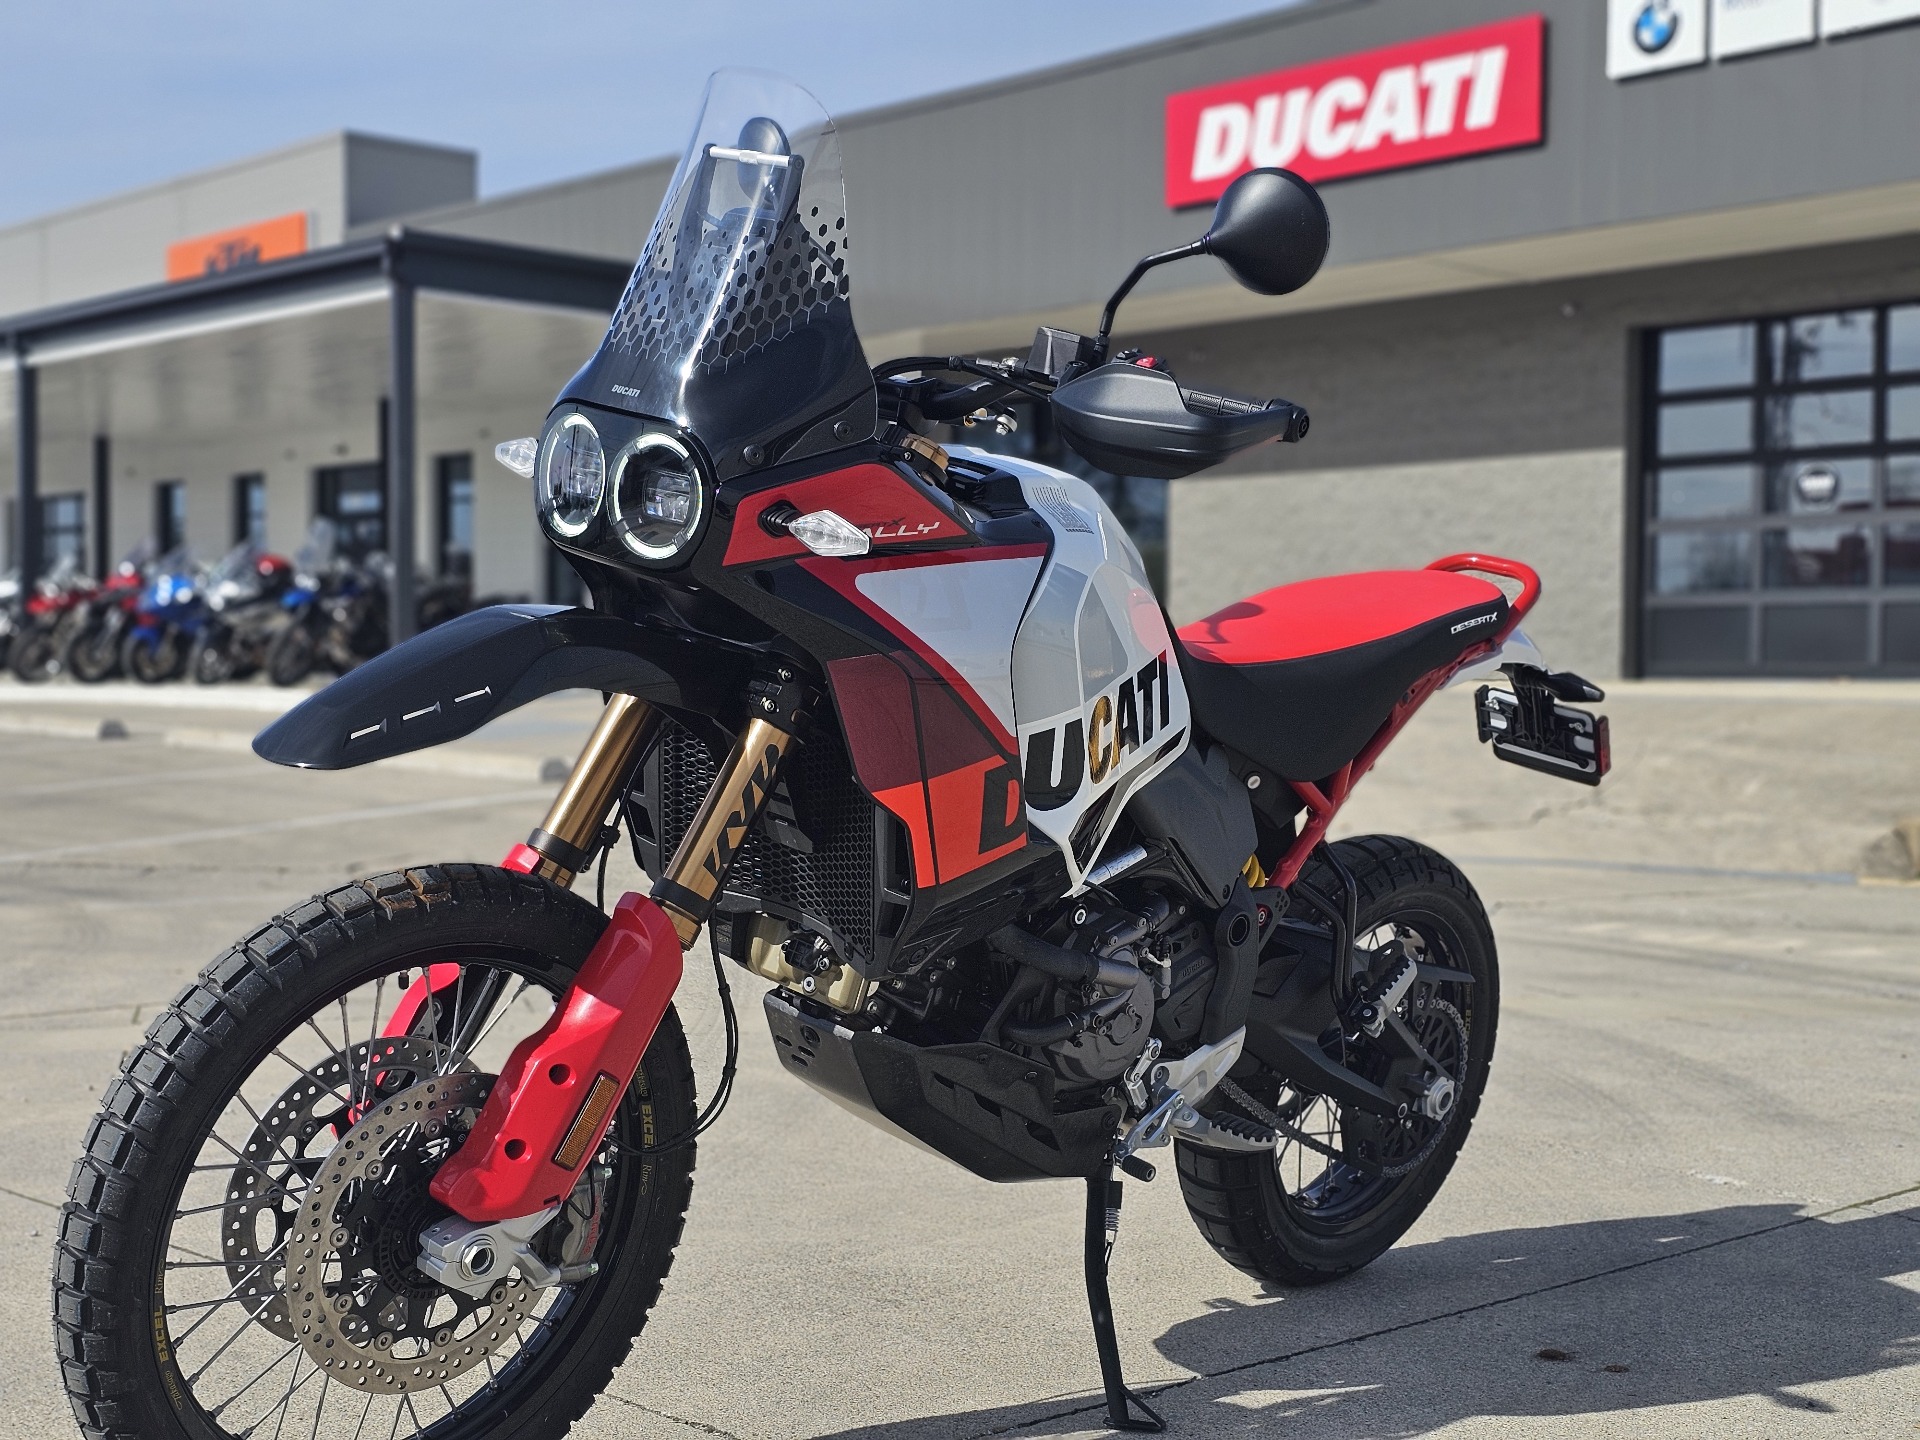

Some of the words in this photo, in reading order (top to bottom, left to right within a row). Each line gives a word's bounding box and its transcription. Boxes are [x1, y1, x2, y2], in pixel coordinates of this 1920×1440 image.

[1191, 45, 1508, 181] DUCATI
[611, 384, 641, 398] DUCATI
[861, 521, 941, 538] ALLY
[978, 648, 1171, 855] DUCATI
[641, 1104, 655, 1149] EXCE
[154, 1305, 170, 1365] EXCEL
